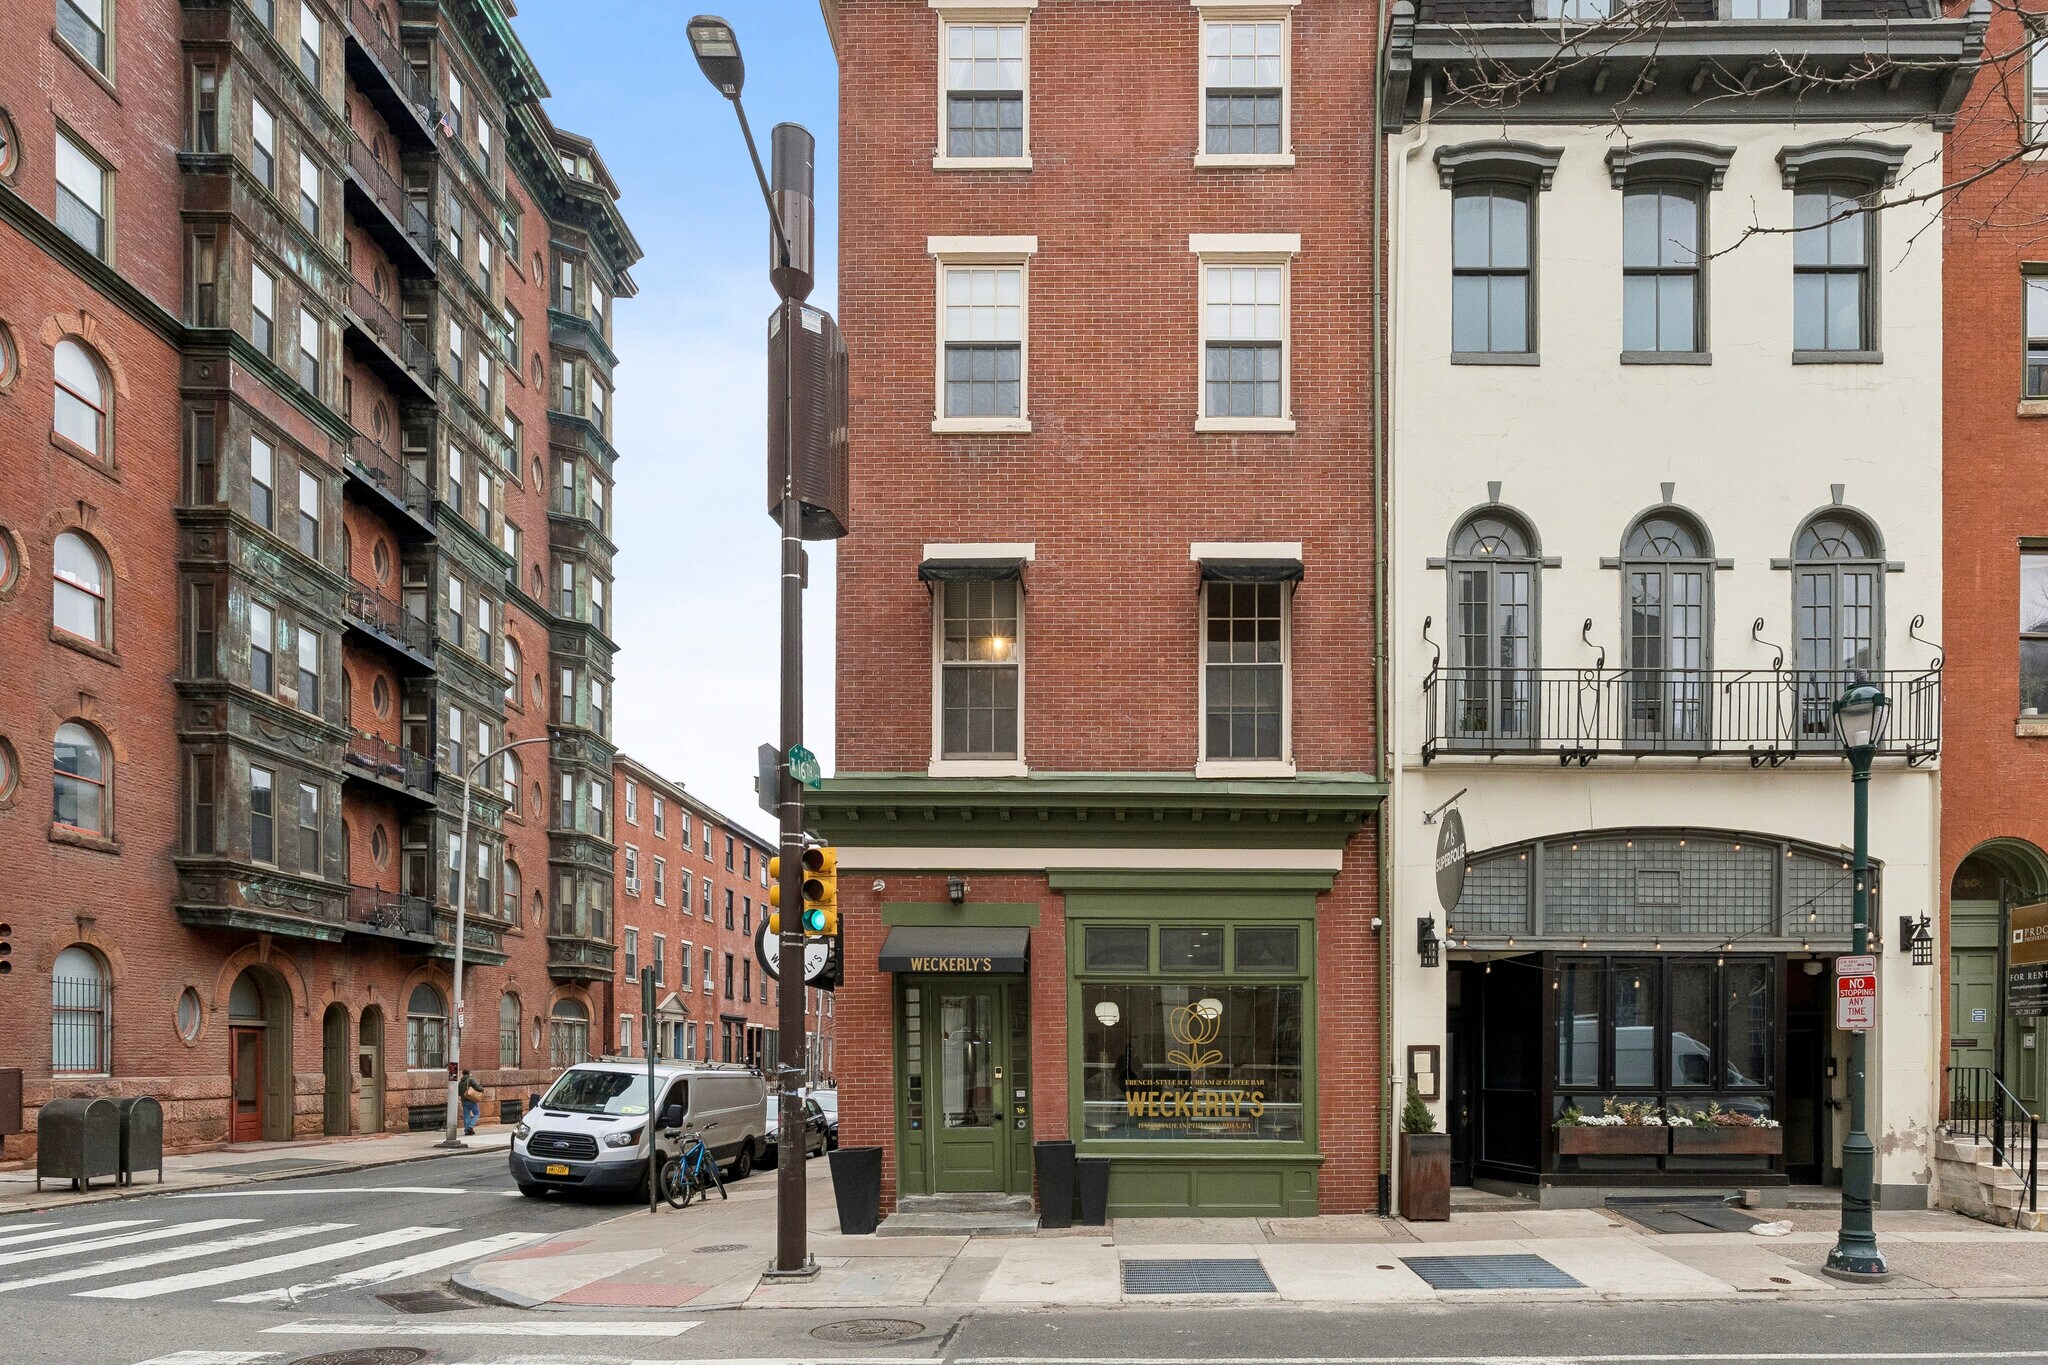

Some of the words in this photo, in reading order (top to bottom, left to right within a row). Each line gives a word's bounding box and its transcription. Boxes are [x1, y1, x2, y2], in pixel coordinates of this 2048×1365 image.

[1436, 843, 1465, 872] SUPERFOLIE
[2024, 925, 2048, 937] PRDC
[911, 957, 992, 972] WECKERLY'S
[2010, 973, 2024, 981] FOR
[2028, 970, 2048, 980] RENT
[1849, 978, 1865, 989] NO
[1840, 988, 1874, 997] STOPPING
[1849, 998, 1865, 1006] ANY
[1848, 1007, 1865, 1016] TIME
[1125, 1091, 1265, 1117] WECKERLY'S
